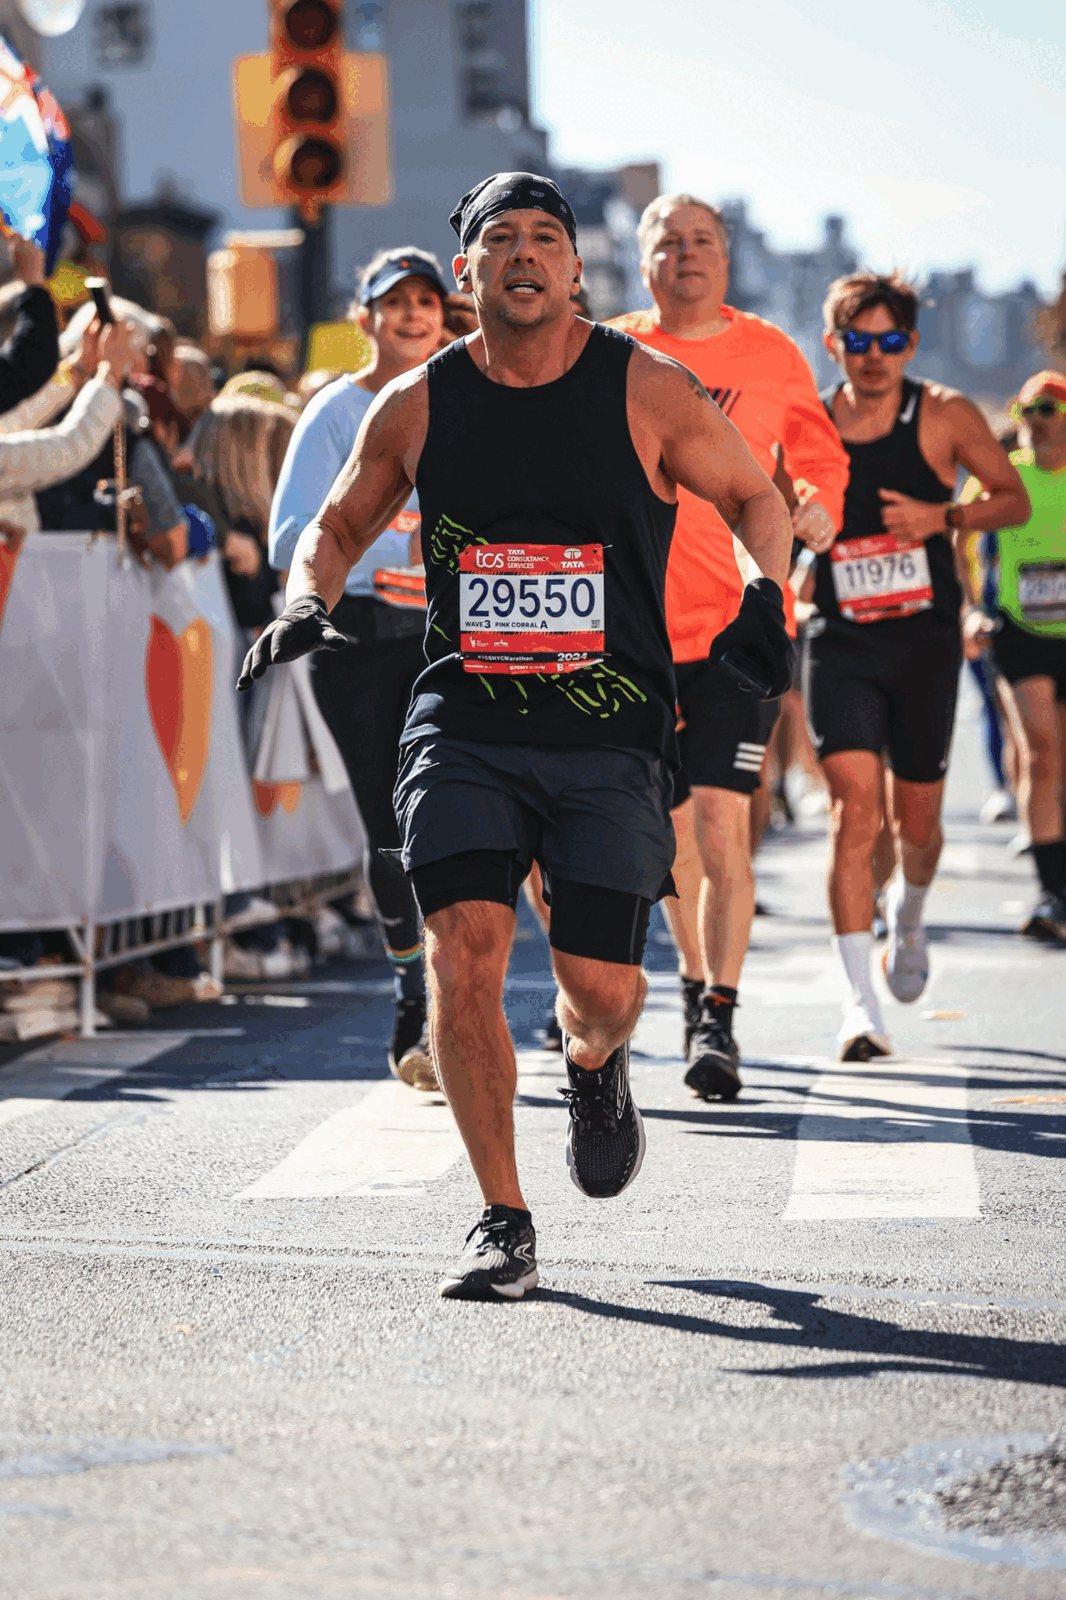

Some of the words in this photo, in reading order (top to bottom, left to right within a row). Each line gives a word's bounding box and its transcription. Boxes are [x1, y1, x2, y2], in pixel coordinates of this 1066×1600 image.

[475, 549, 504, 568] tcs
[844, 552, 917, 590] 11976
[468, 577, 595, 617] 29550
[484, 620, 491, 629] 3
[540, 620, 548, 629] A
[557, 652, 588, 662] 2024
[557, 663, 564, 671] B
